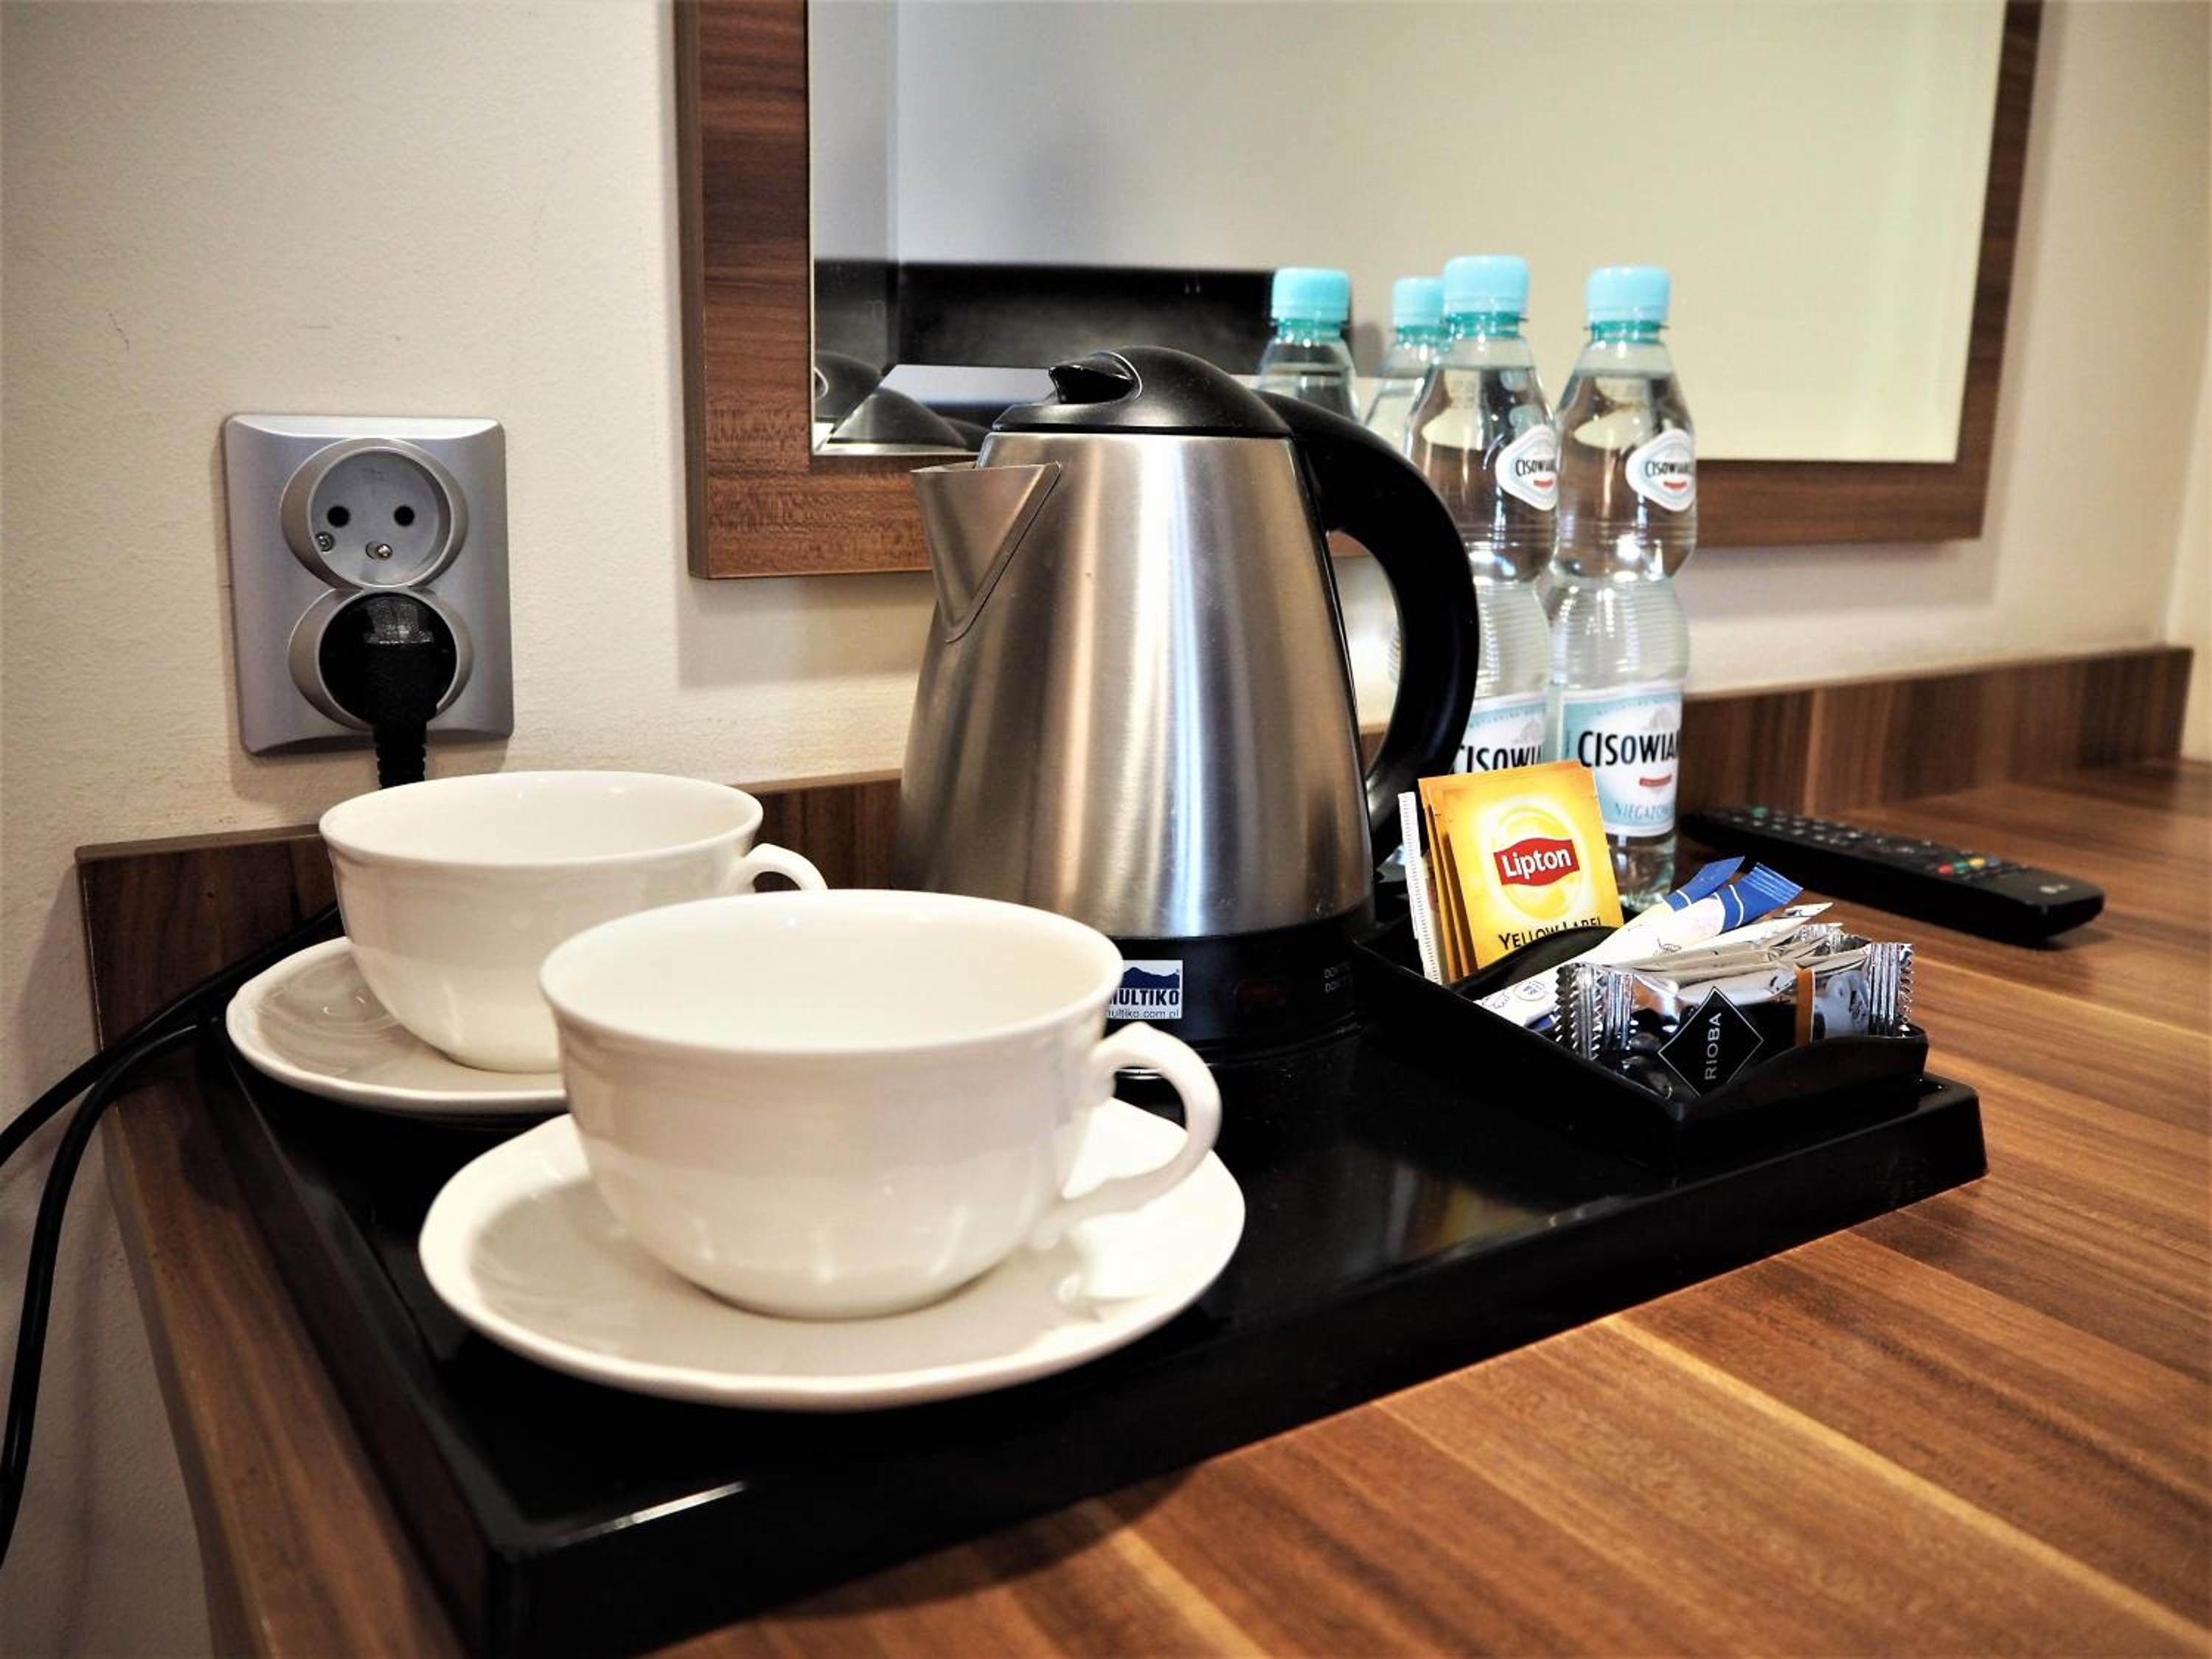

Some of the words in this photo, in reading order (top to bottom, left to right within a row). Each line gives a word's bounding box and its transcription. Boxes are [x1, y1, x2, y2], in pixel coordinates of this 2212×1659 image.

[1450, 744, 1542, 773] ISOWI
[1501, 849, 1572, 879] Lipton
[1703, 1012, 1722, 1081] RIOBA
